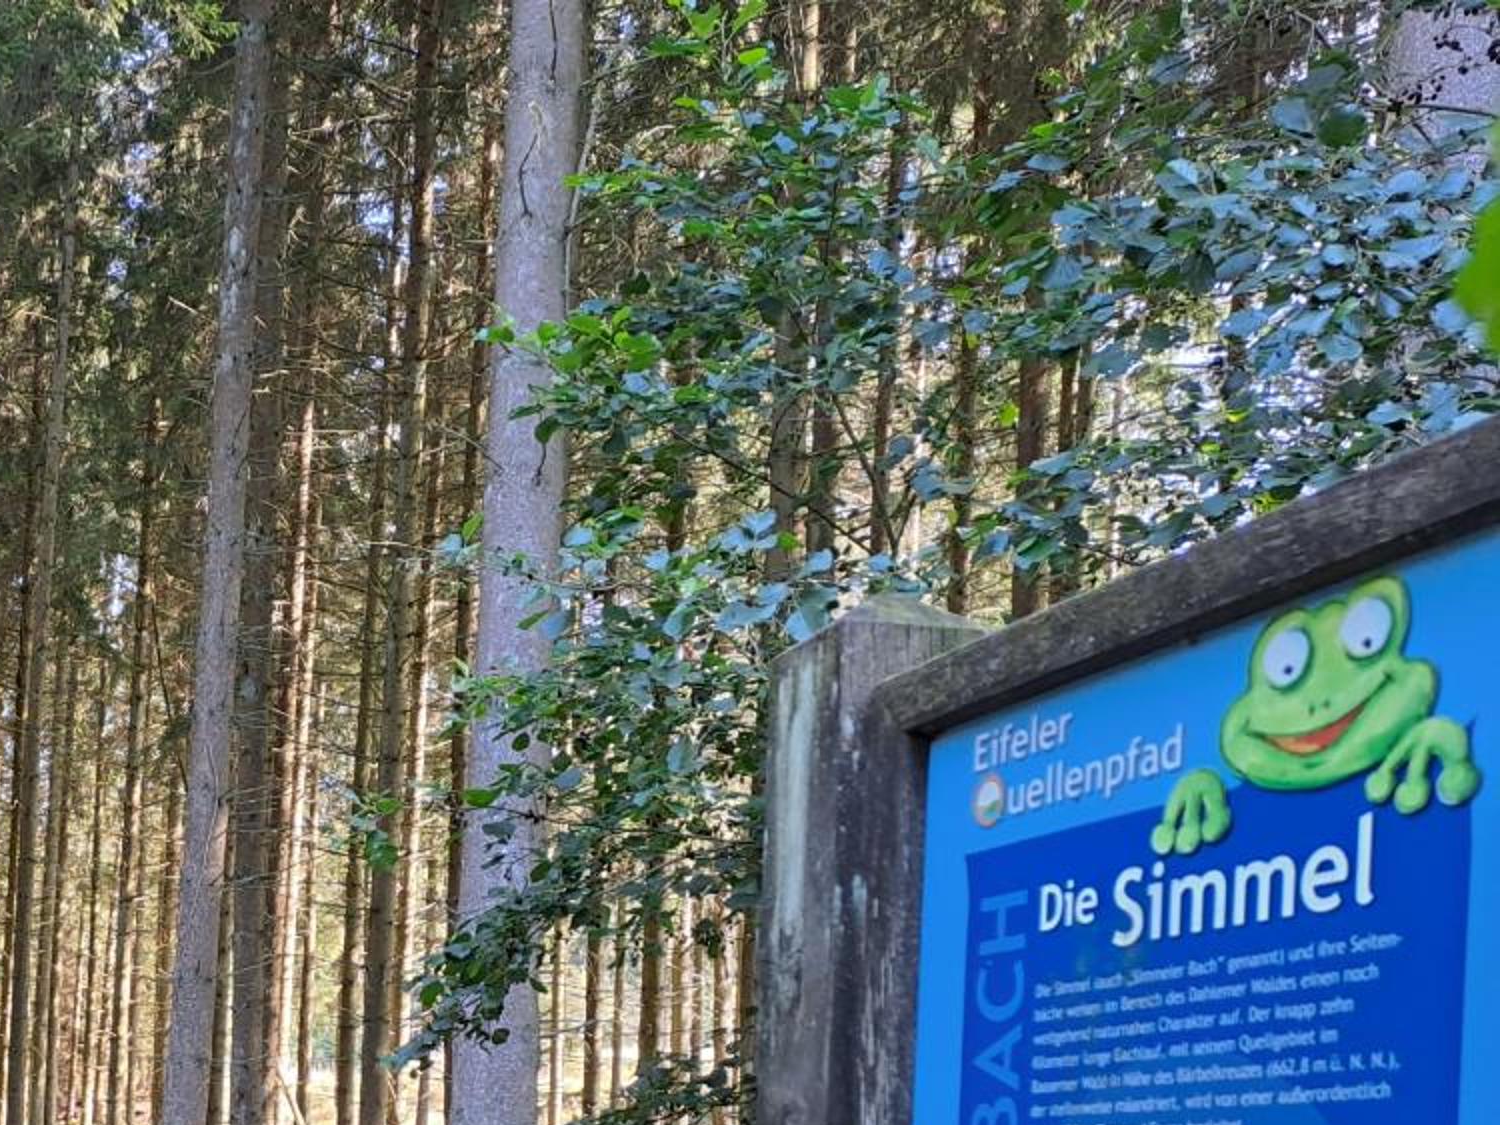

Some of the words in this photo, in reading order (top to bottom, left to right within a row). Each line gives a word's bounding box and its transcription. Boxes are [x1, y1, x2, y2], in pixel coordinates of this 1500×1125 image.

[973, 711, 1073, 774] Eifeler
[1038, 881, 1098, 933] Die
[1112, 811, 1375, 949] Simmel
[1287, 941, 1314, 962] und
[1316, 936, 1347, 958] ihre
[1349, 927, 1403, 954] Seiten-
[1164, 987, 1186, 1006] des
[1249, 973, 1297, 996] Waldes
[1300, 967, 1340, 990] einen
[1342, 962, 1379, 985] noch
[1156, 1011, 1215, 1033] Charakter
[1218, 1007, 1243, 1026] auf.
[1247, 1004, 1271, 1023] Der
[1273, 999, 1316, 1024] knapp
[1319, 995, 1354, 1016] zehn
[1168, 1041, 1189, 1057] mit
[1191, 1036, 1236, 1055] seinem
[1237, 1029, 1316, 1054] Quellgebiet
[1319, 1027, 1338, 1044] im
[1153, 1068, 1174, 1085] des
[1312, 1058, 1327, 1074] m
[1349, 1052, 1365, 1071] N.
[1214, 1093, 1237, 1107] von
[1239, 1088, 1273, 1106] einer
[1277, 1080, 1391, 1103] außerordentlich
